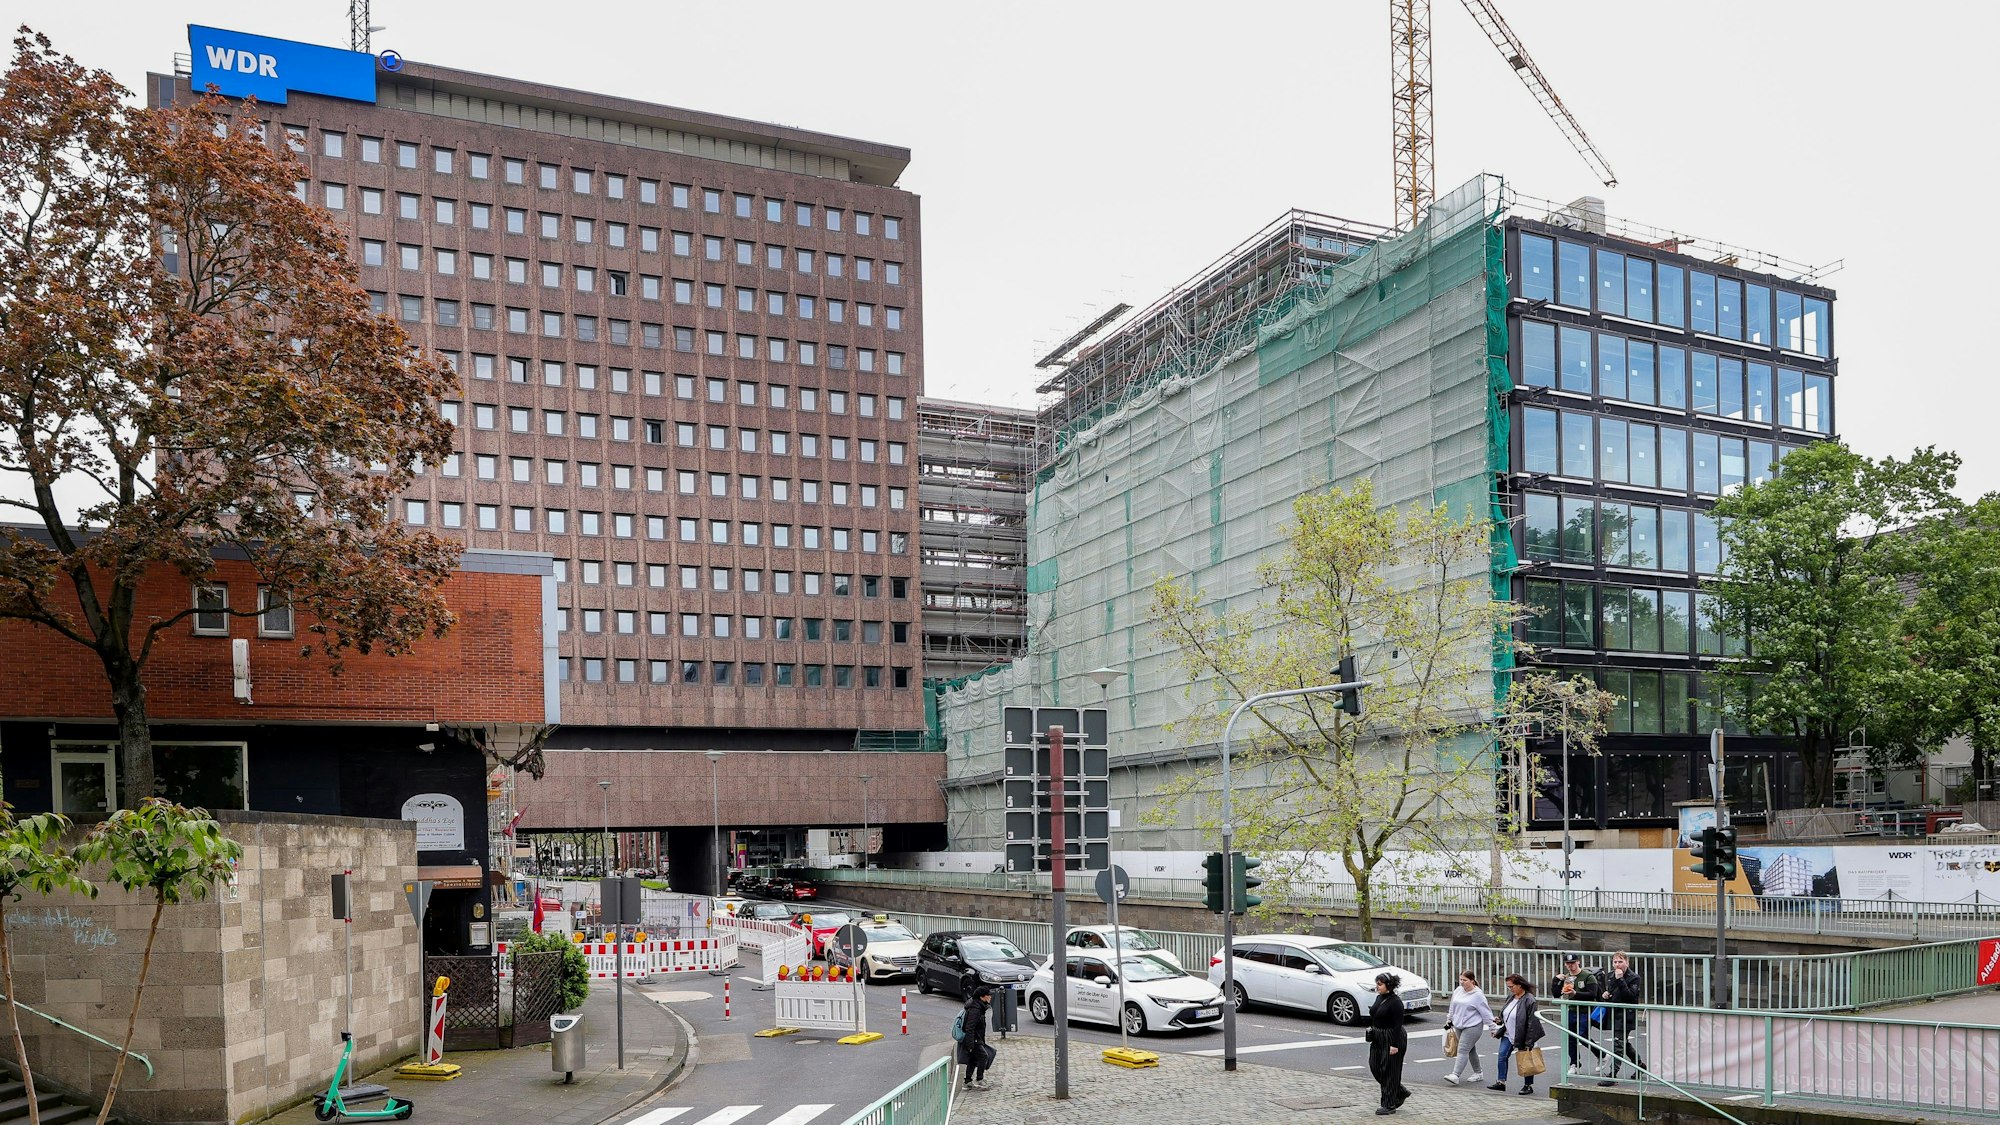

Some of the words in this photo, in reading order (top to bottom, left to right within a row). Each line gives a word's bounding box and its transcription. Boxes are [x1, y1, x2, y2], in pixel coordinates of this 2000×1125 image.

[205, 45, 279, 79] WDR
[1888, 851, 1913, 859] WDR
[73, 924, 117, 952] Rights
